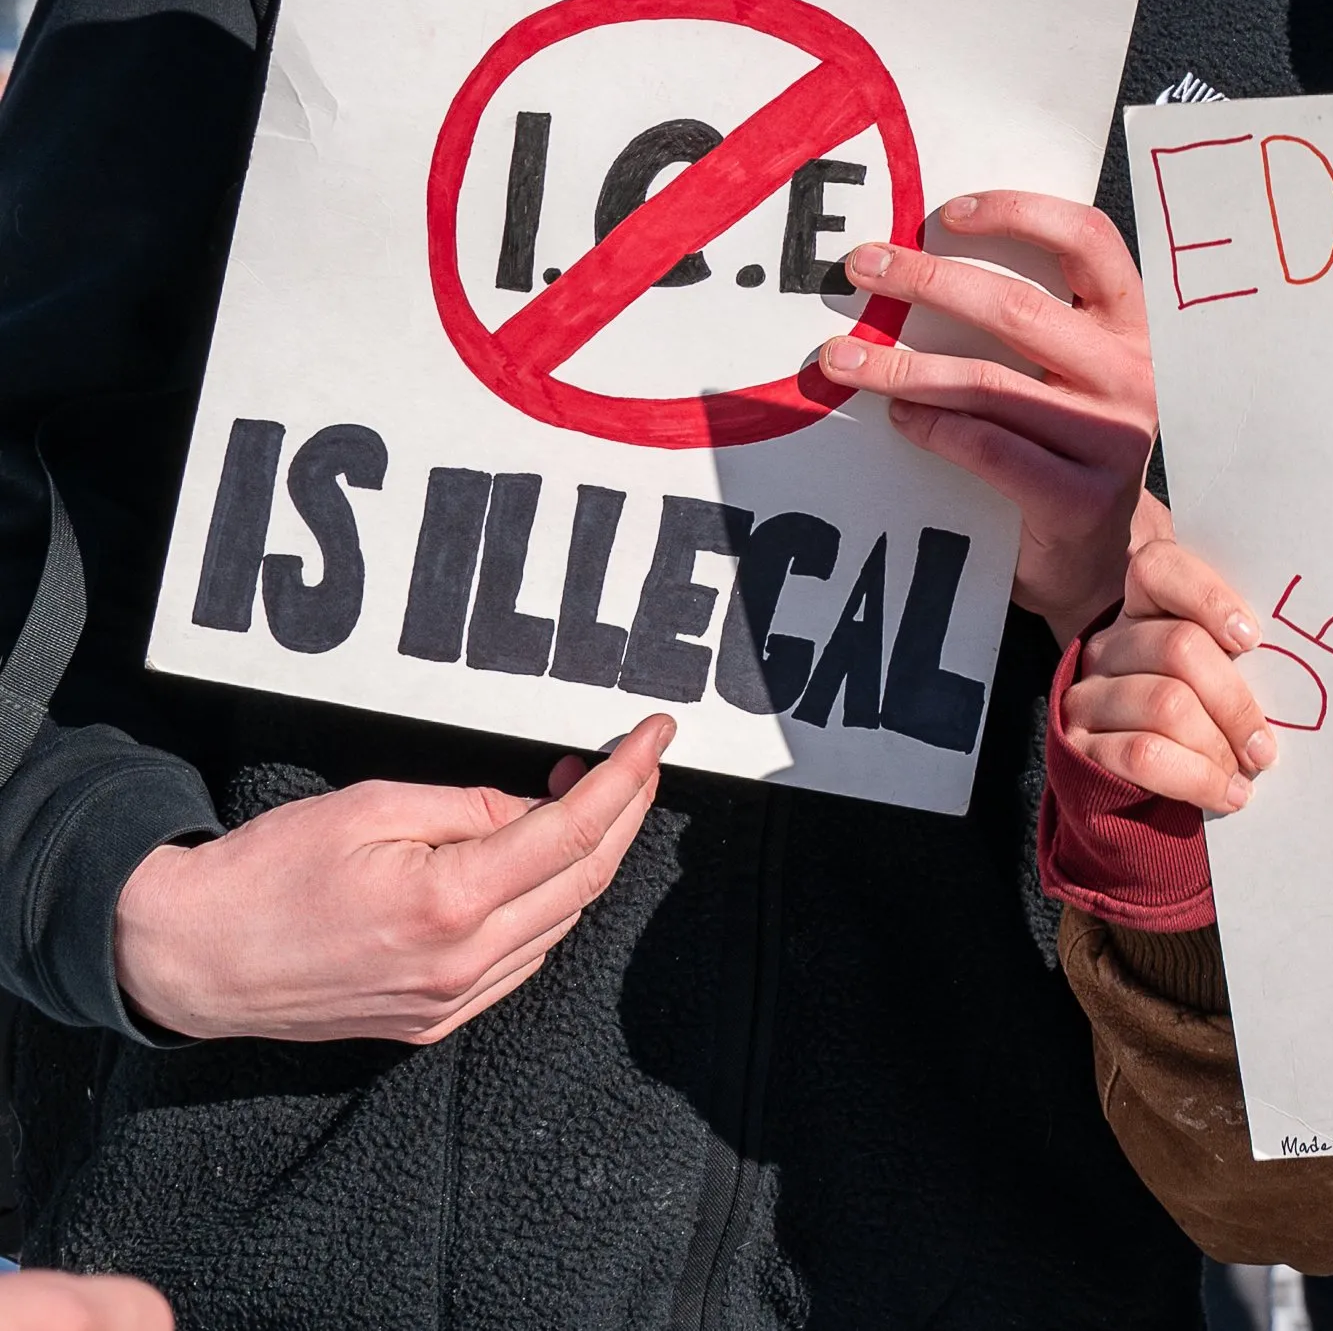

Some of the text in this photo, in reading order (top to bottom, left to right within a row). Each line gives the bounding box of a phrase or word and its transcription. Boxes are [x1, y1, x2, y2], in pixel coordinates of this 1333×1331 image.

[1171, 71, 1231, 103] NIK
[190, 419, 987, 755] IS ILLEGAL
[1281, 1135, 1333, 1157] Made
